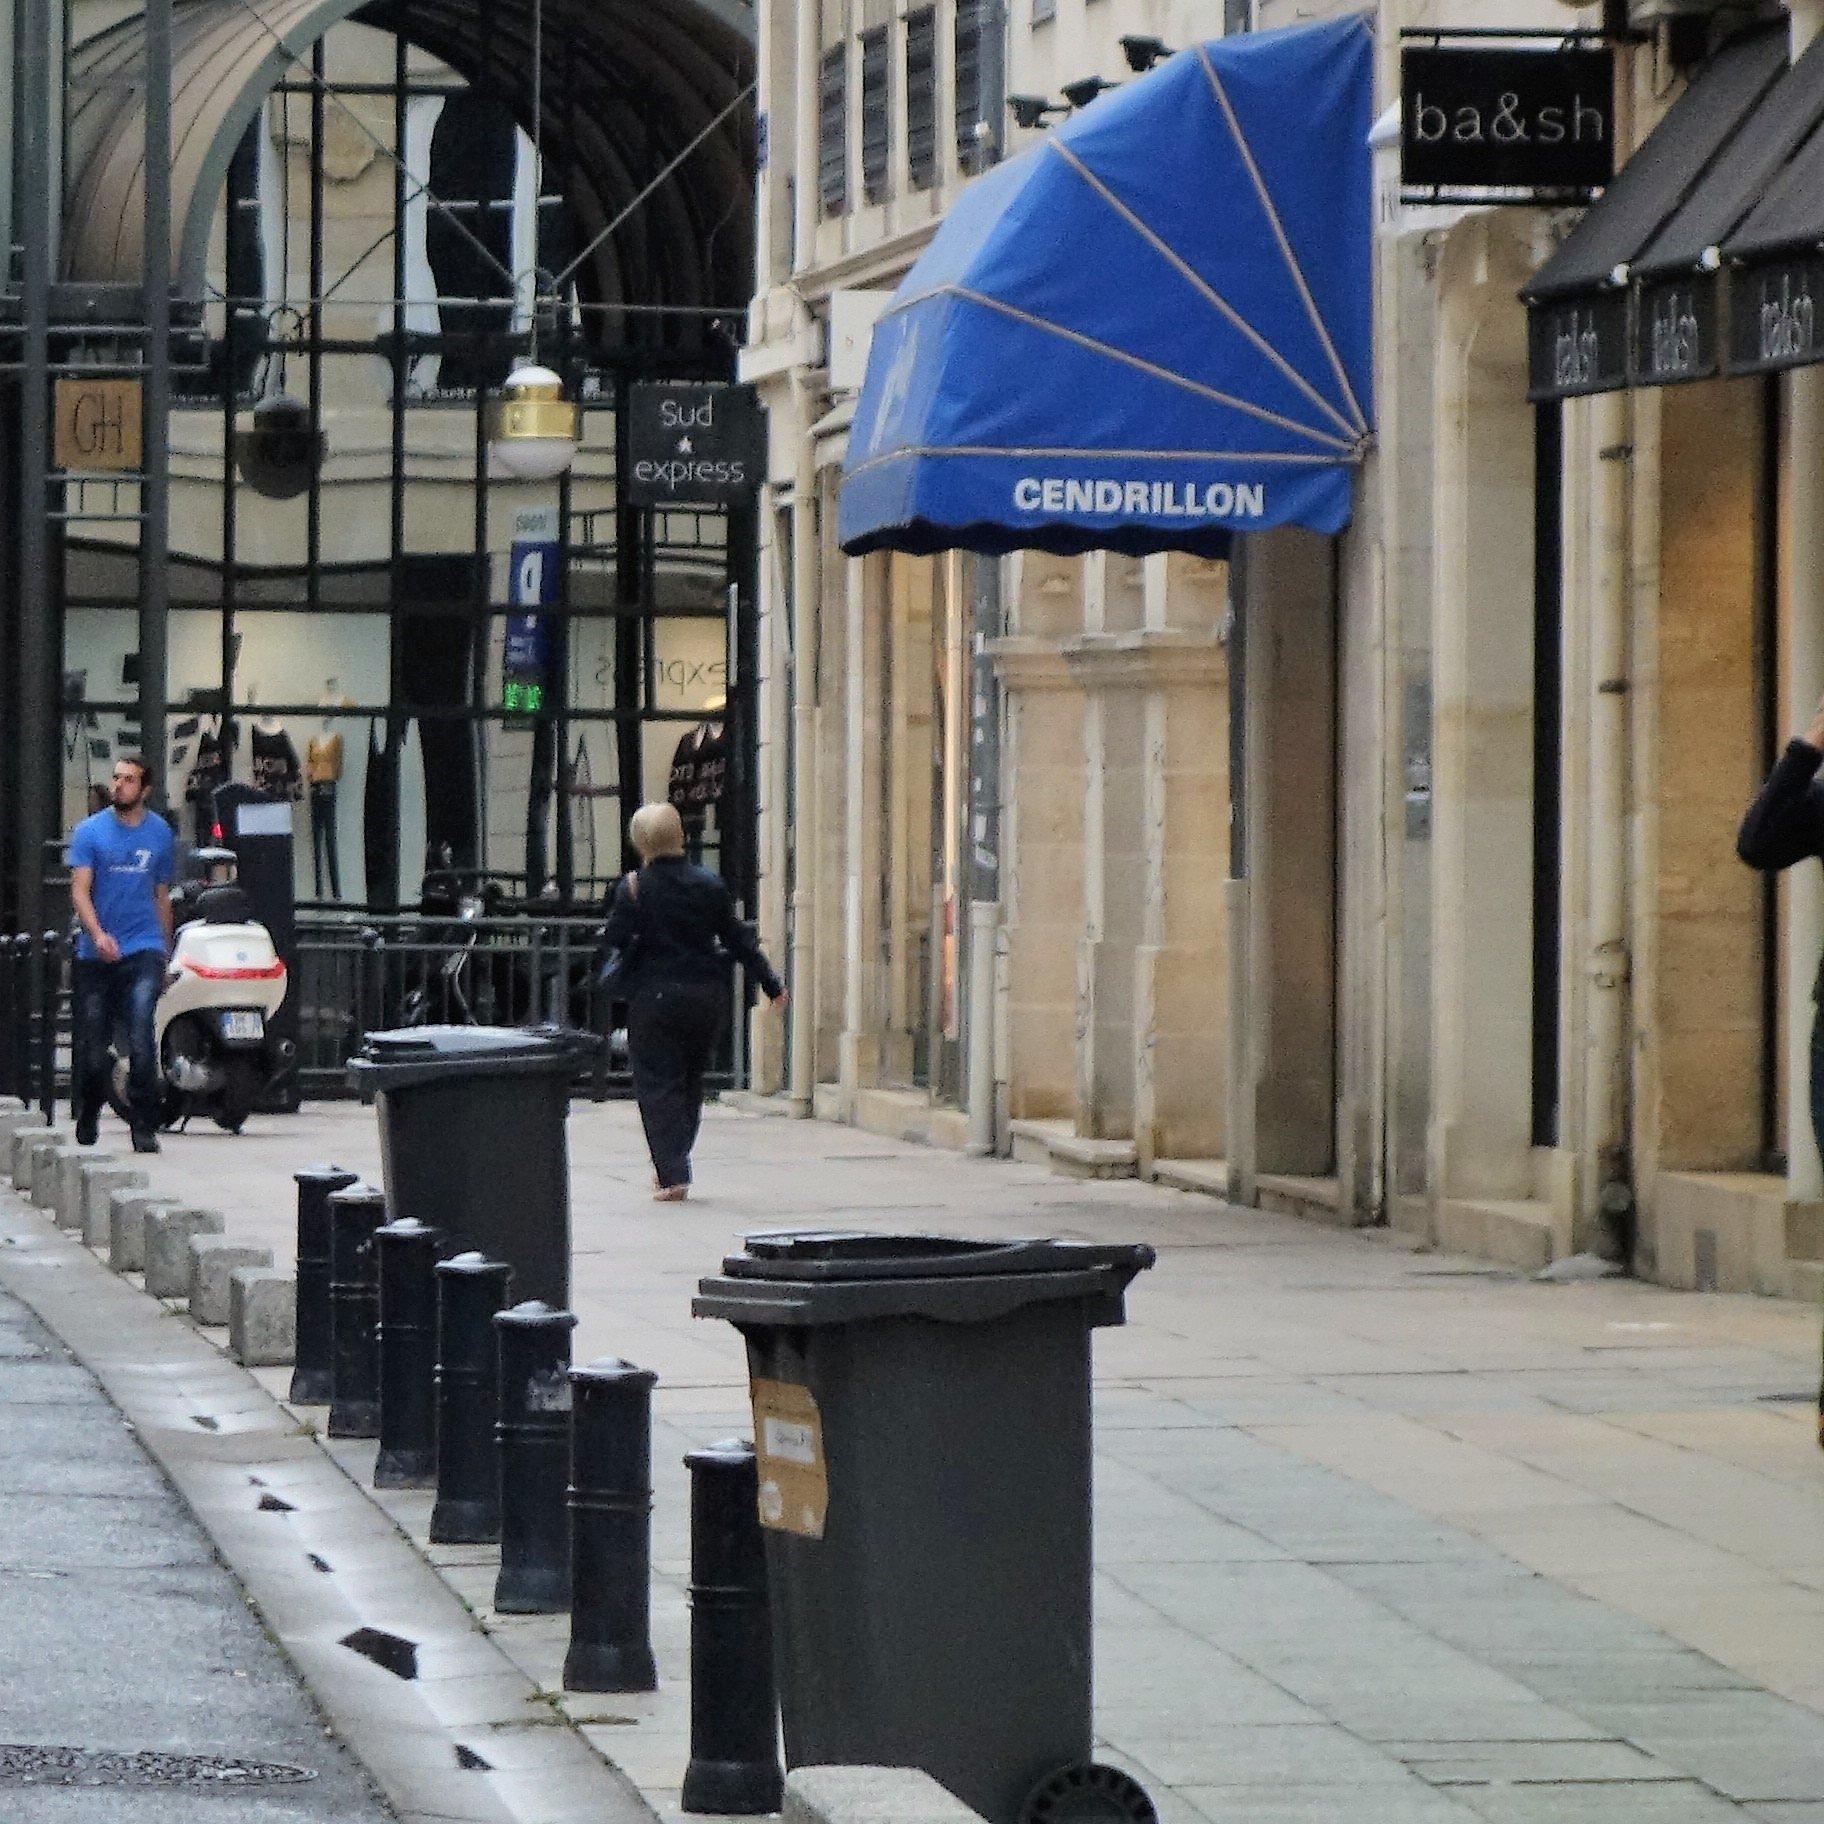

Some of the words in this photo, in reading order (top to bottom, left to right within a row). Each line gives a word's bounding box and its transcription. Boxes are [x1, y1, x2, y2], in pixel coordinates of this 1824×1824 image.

[1415, 91, 1603, 142] ba&sh
[661, 394, 713, 427] Sud
[635, 459, 745, 491] express
[1013, 477, 1265, 518] CENDRILLON
